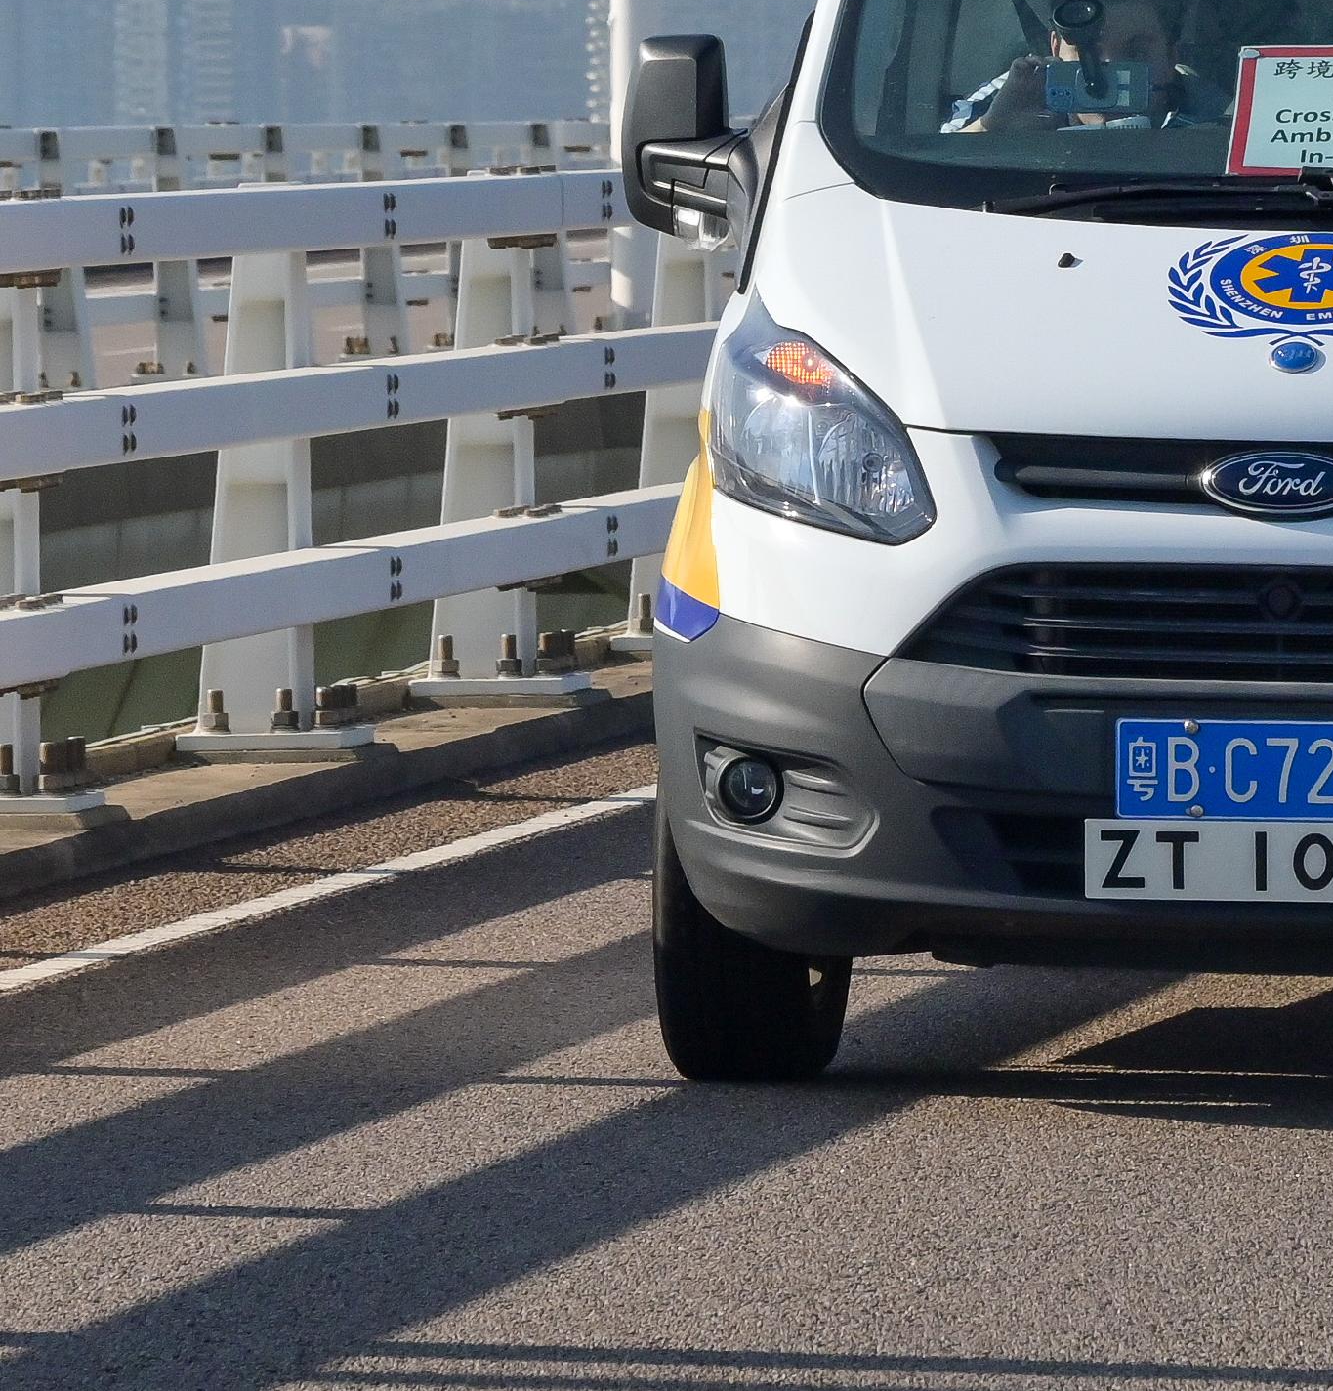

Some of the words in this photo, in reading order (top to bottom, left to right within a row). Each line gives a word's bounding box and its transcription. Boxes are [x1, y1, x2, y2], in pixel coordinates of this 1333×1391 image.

[1220, 278, 1284, 320] SHENZHEN
[1238, 460, 1327, 497] Ford
[1100, 829, 1200, 890] ZT
